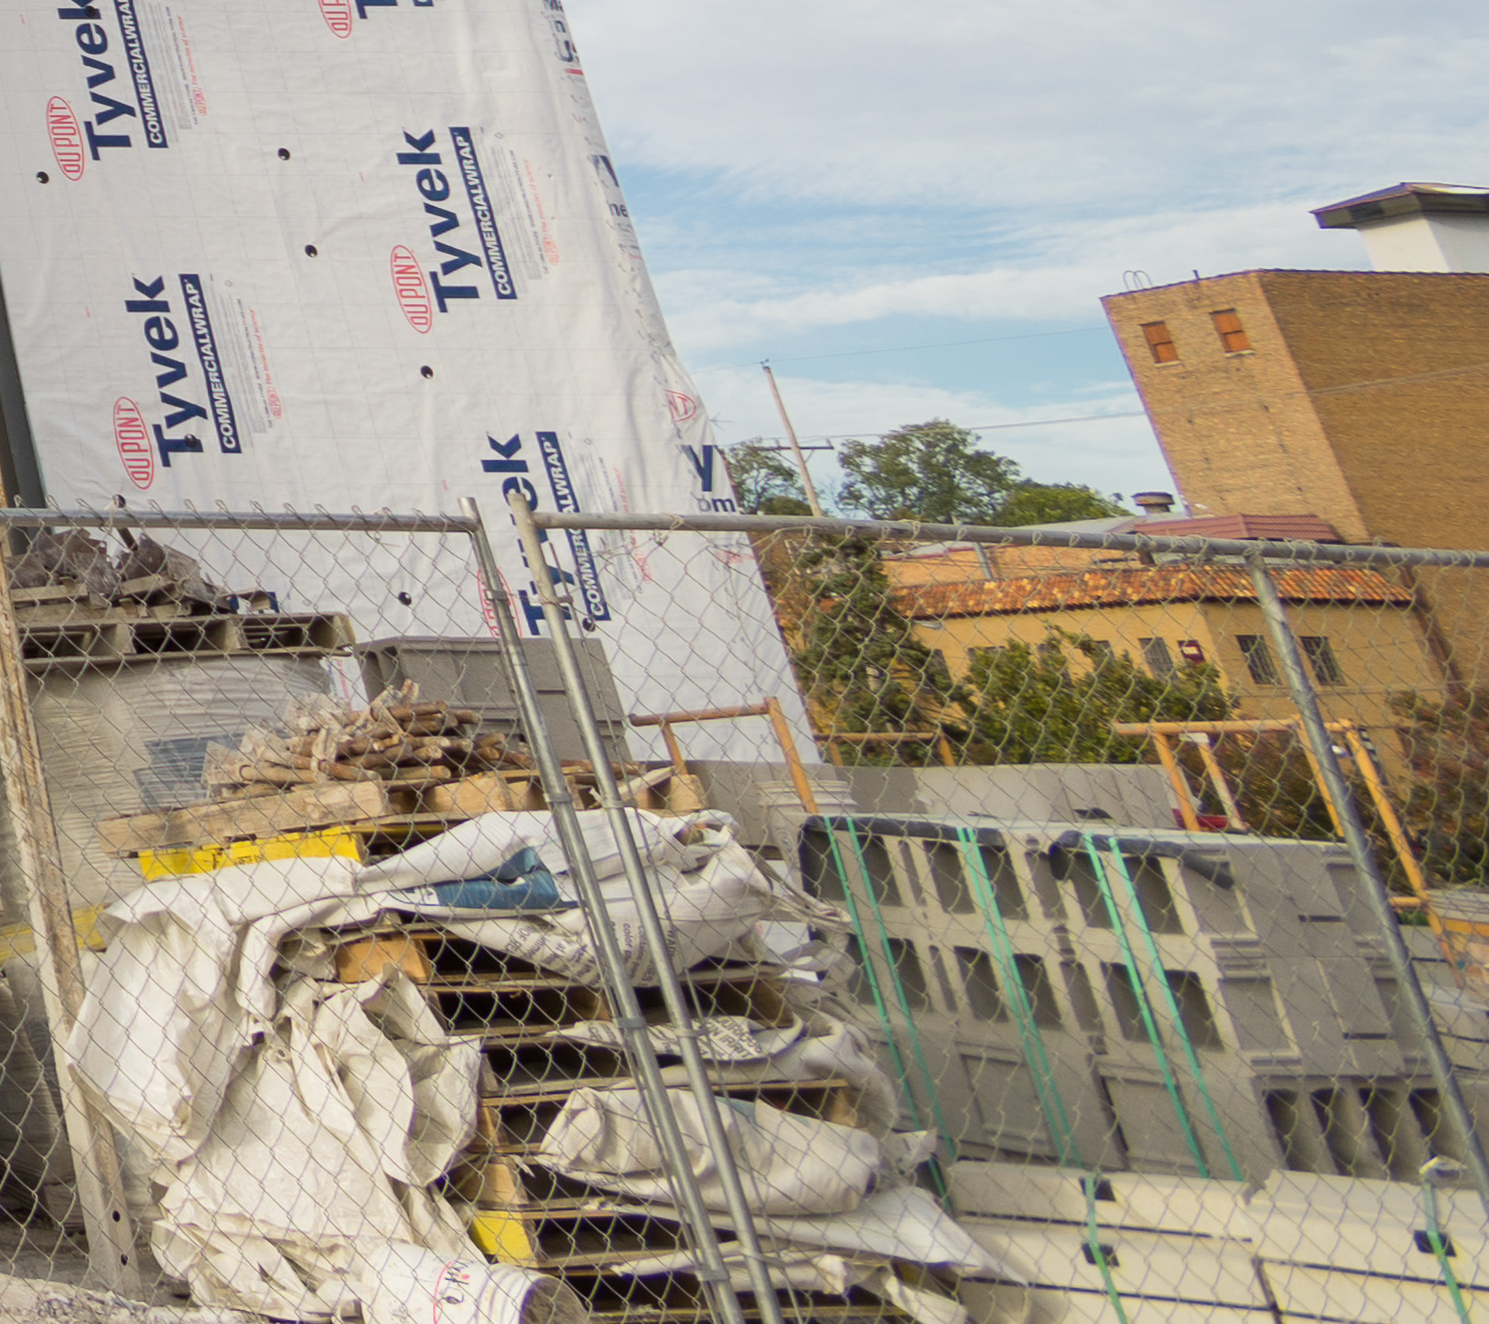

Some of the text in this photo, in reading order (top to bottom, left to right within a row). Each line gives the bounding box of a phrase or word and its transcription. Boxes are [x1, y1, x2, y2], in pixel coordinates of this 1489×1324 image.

[396, 128, 483, 313] Tyvek
[454, 135, 513, 296] COMMERCIALWRAP
[124, 275, 209, 468] Tyvek
[184, 281, 238, 450] COMMERCIALWRAP
